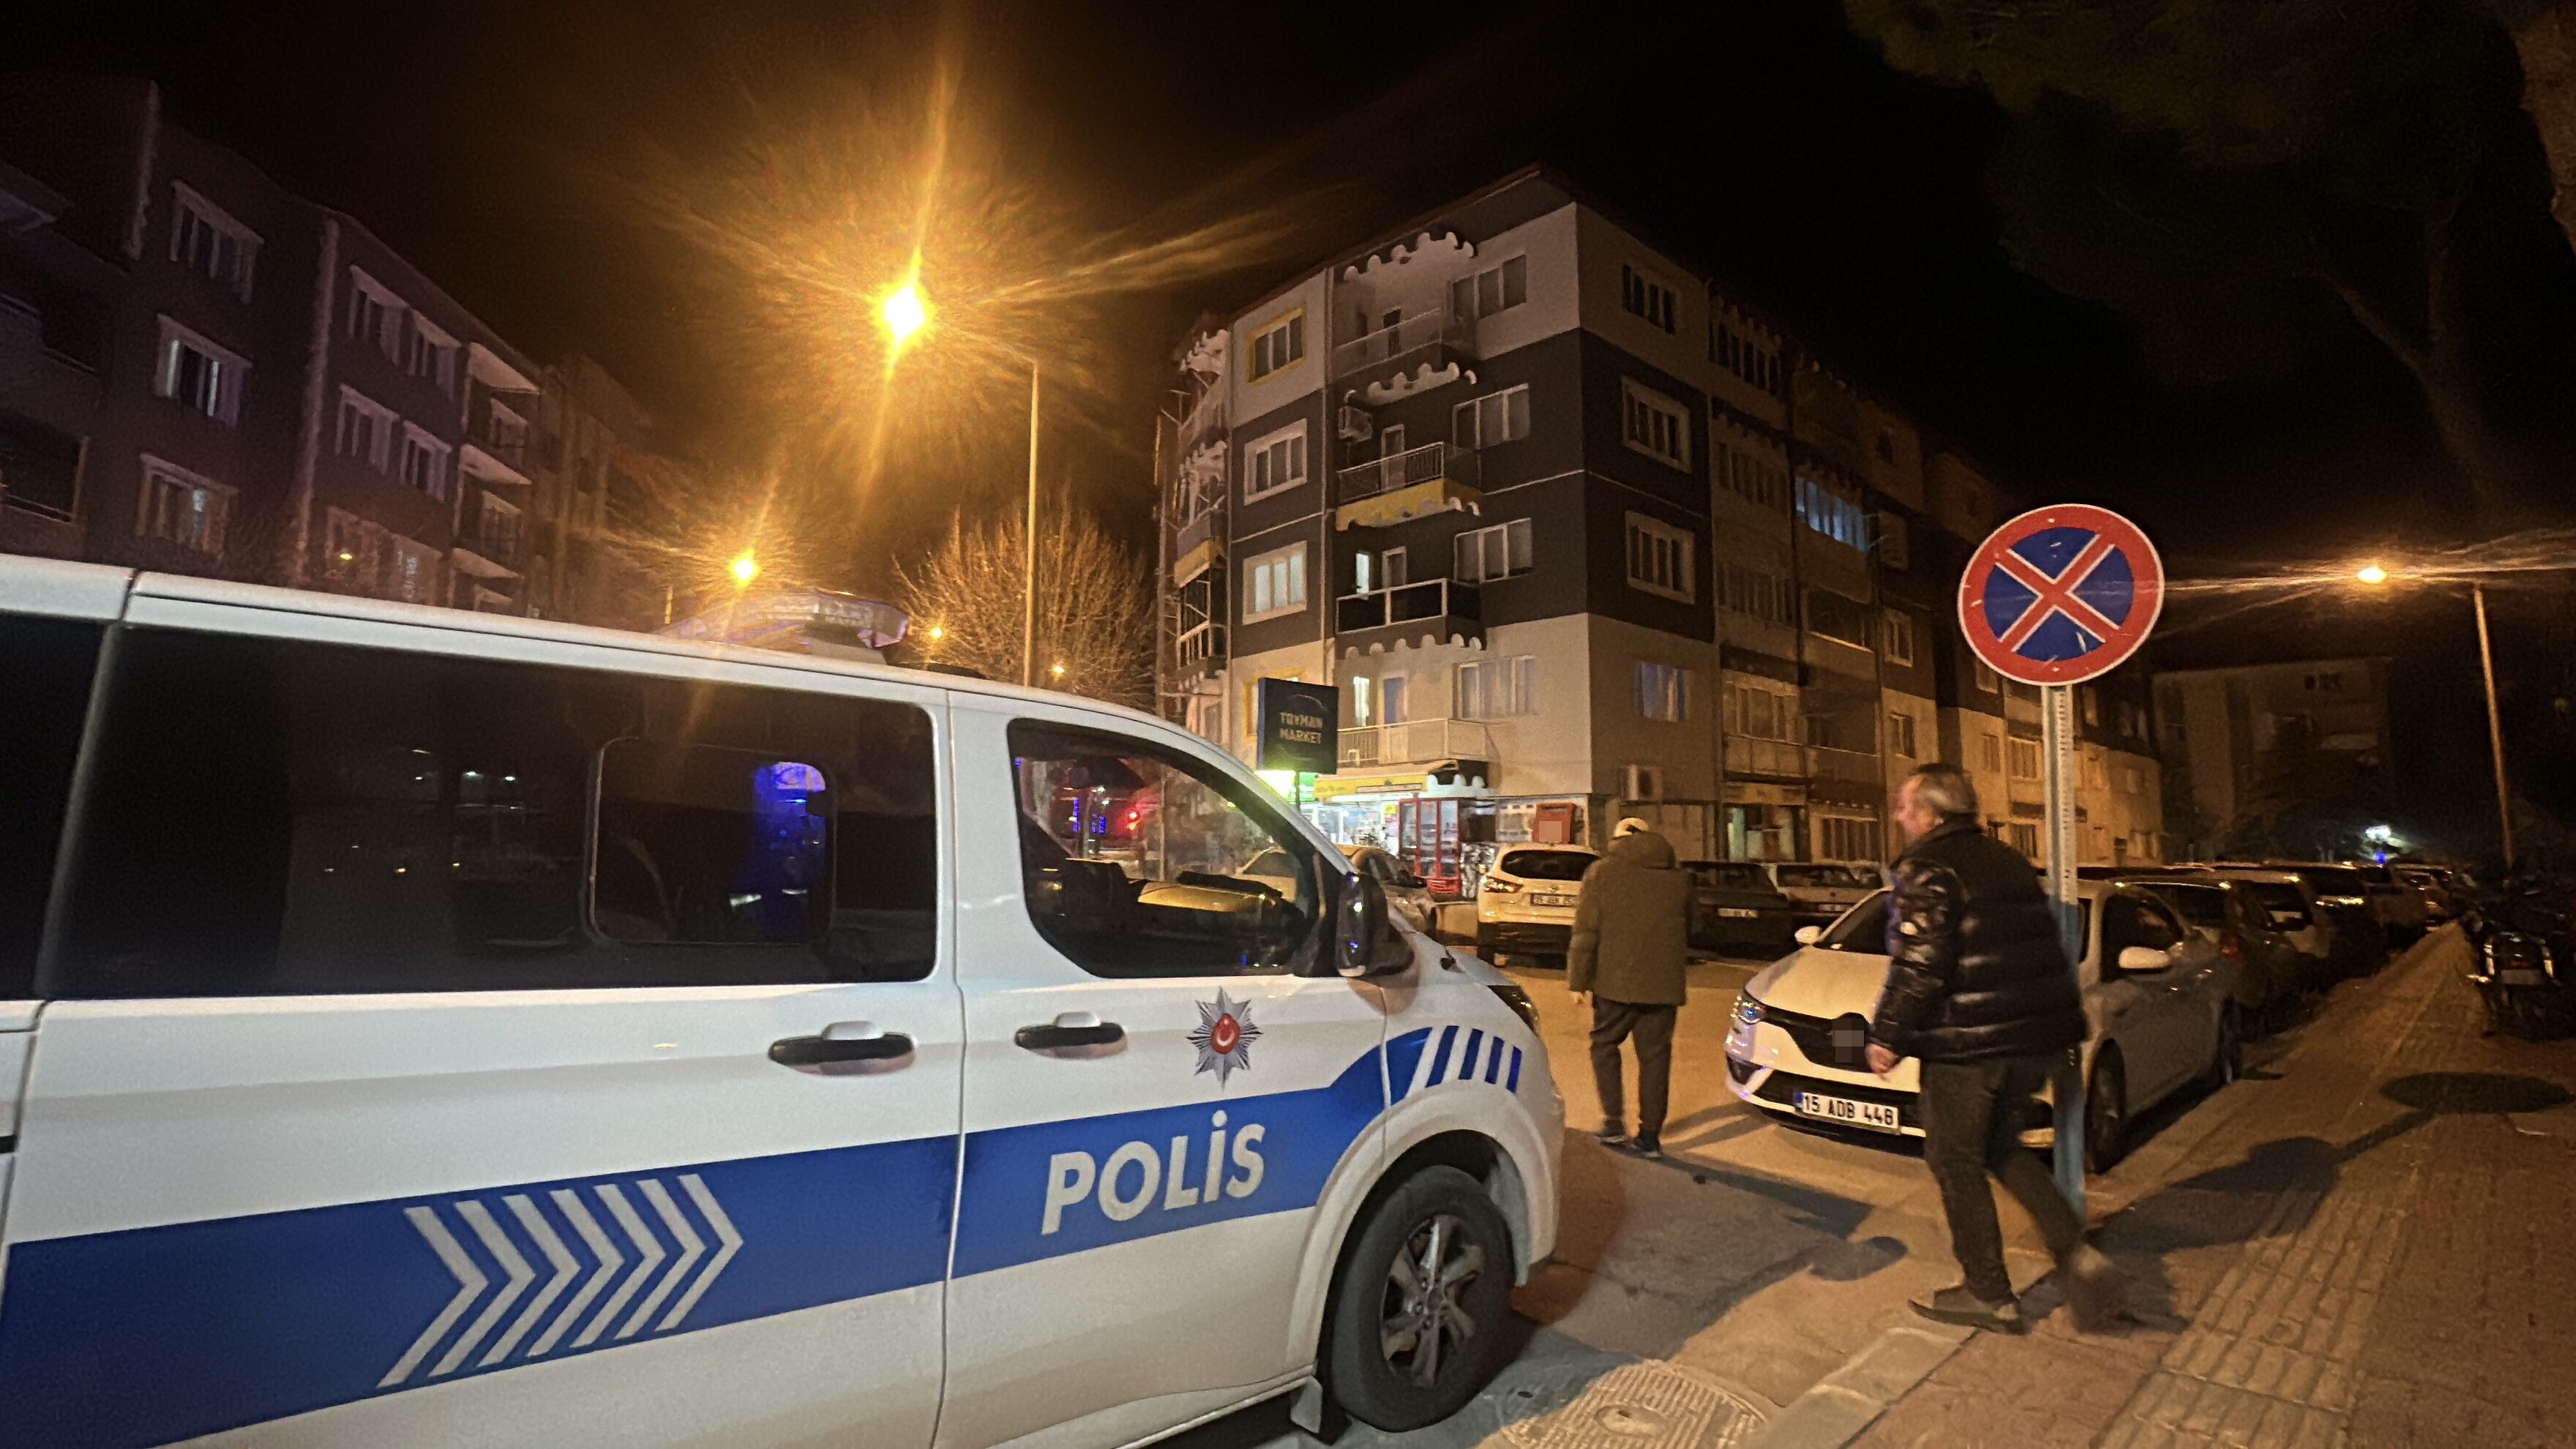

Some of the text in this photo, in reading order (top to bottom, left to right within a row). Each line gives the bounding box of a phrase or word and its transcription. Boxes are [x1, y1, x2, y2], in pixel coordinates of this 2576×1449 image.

[1279, 727, 1322, 744] MARKET
[1805, 1095, 1894, 1126] 15 ADB 448
[1041, 1109, 1266, 1236] POLİS
